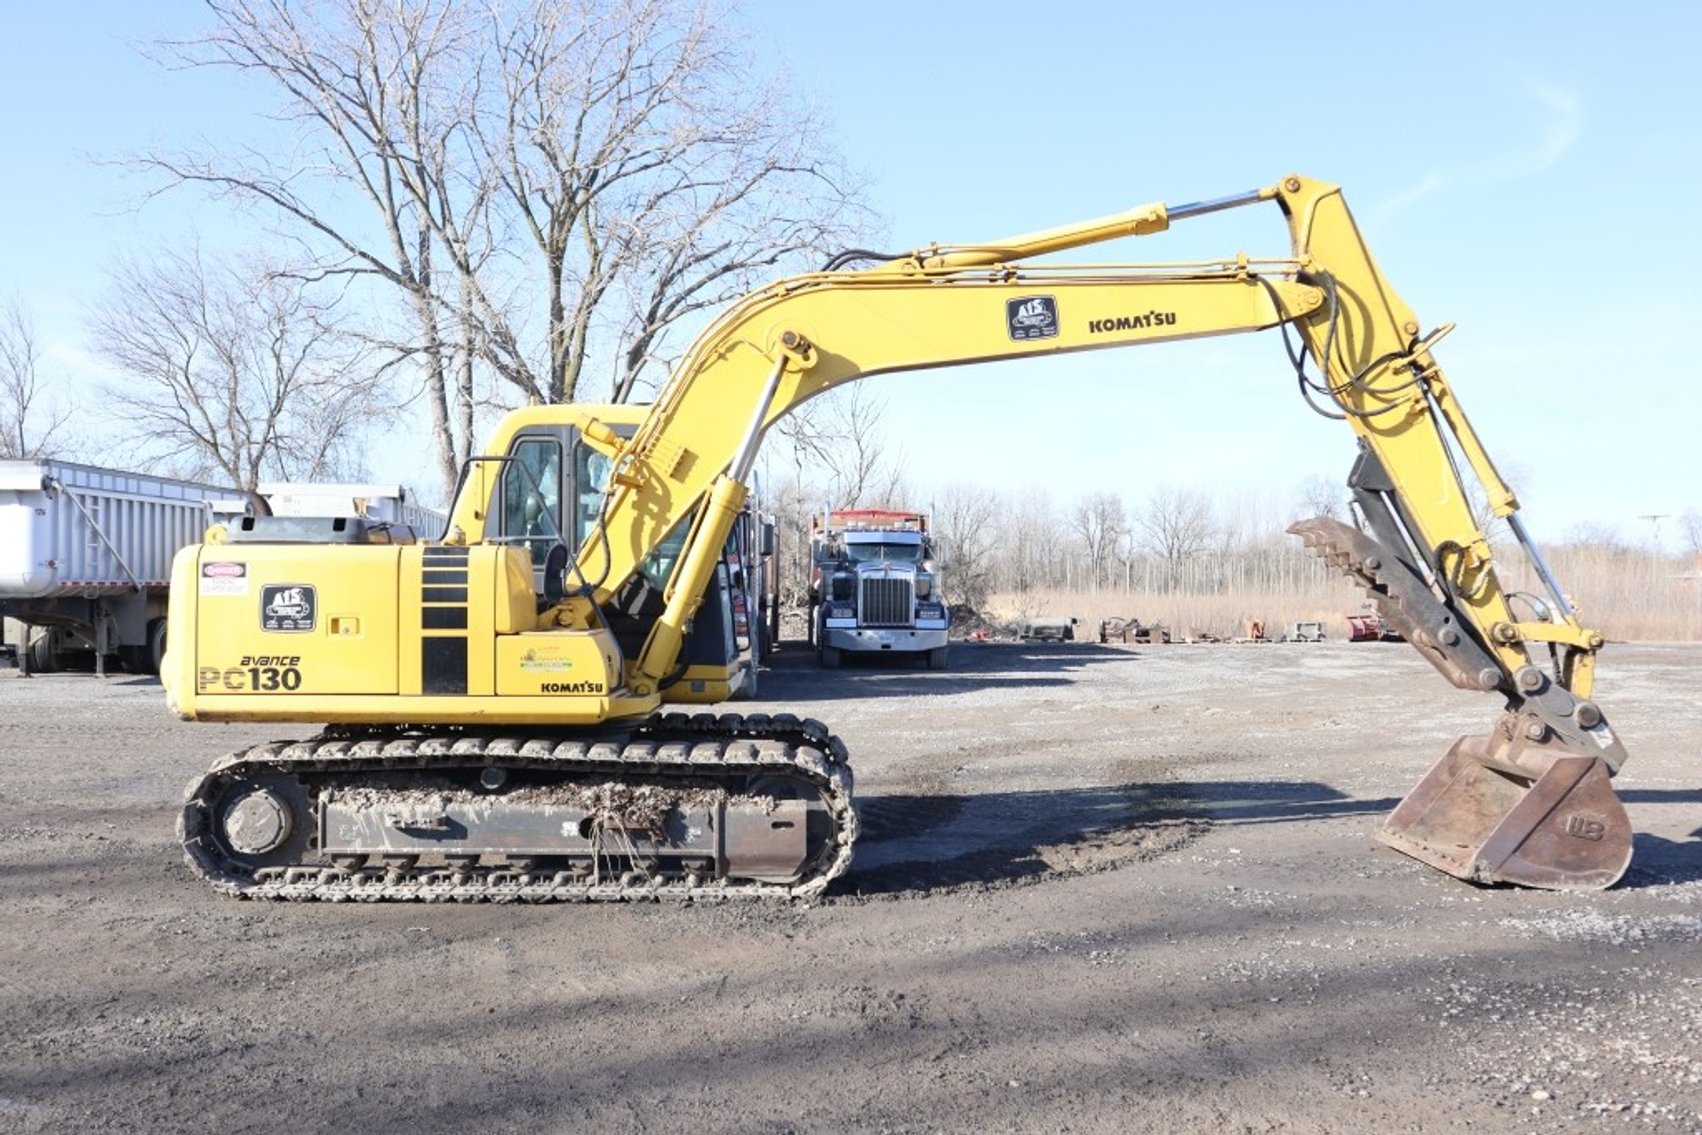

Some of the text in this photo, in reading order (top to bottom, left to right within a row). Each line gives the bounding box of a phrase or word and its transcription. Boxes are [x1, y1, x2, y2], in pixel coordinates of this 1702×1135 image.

[1089, 310, 1176, 333] KOMATSU
[240, 656, 301, 666] avance
[199, 667, 302, 691] PC130
[541, 680, 603, 693] KOMATSU
